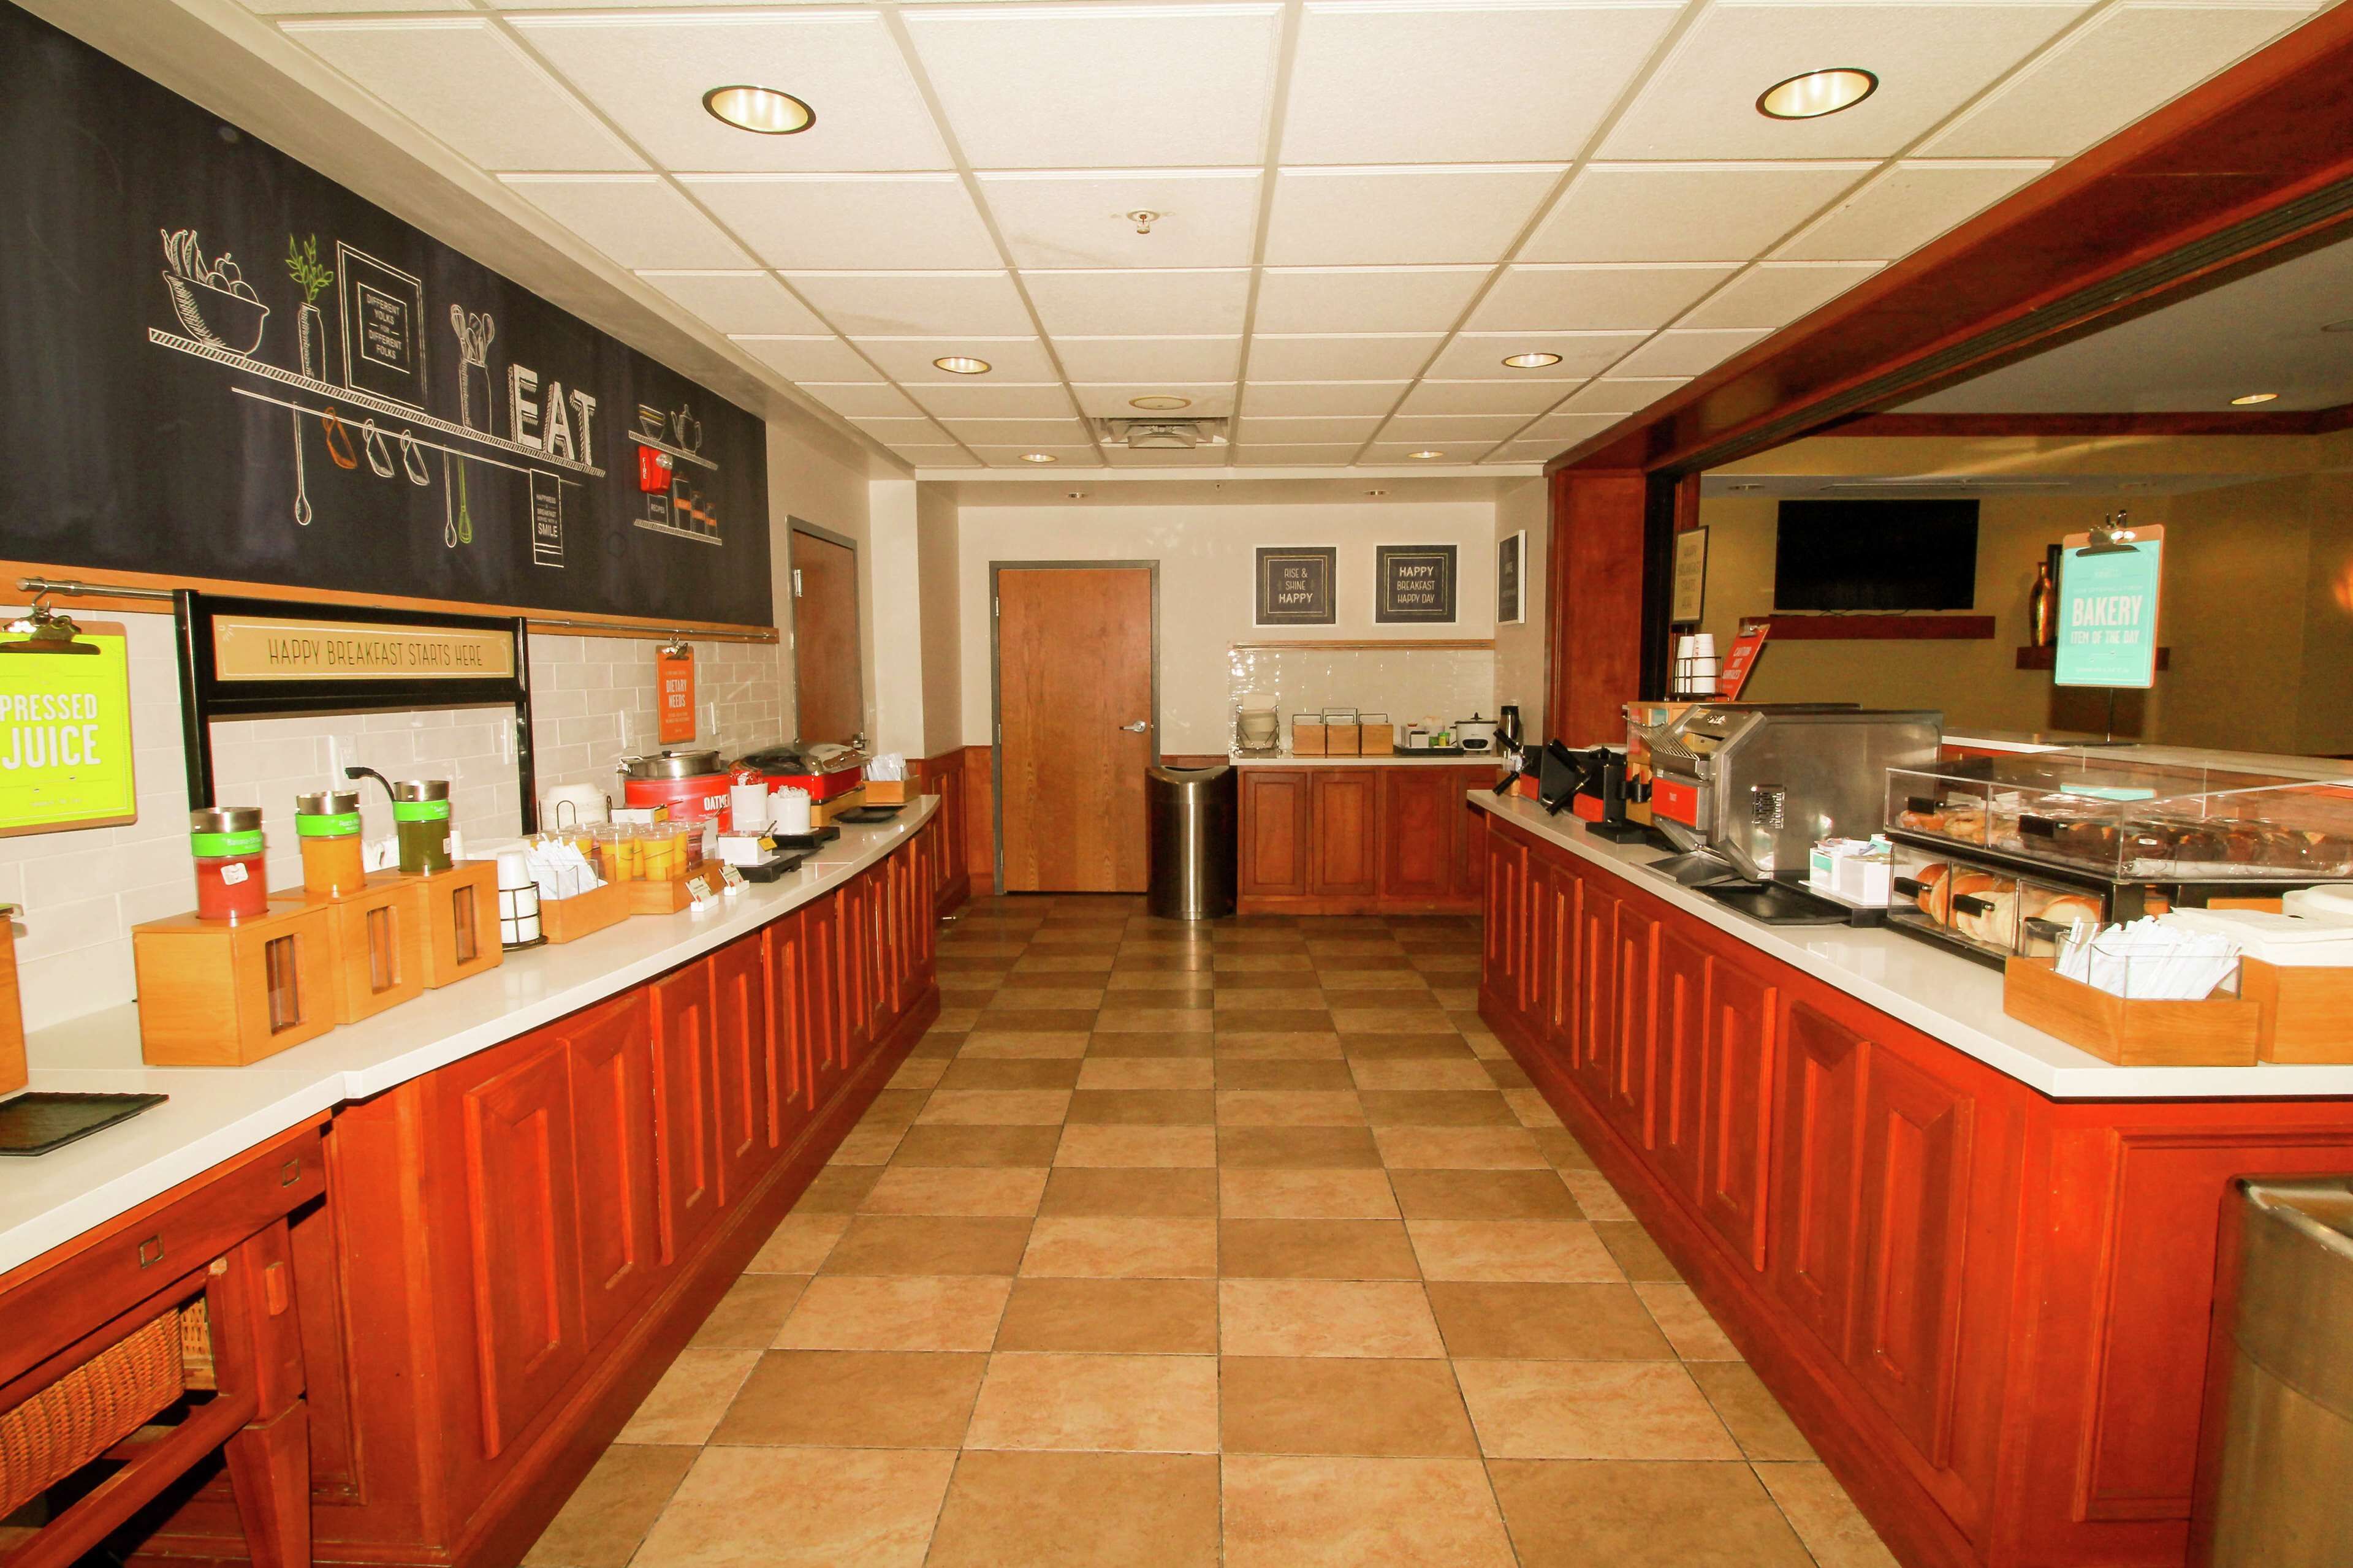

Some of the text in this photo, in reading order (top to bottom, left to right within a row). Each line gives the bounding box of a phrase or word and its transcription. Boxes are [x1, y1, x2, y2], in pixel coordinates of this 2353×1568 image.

[367, 294, 400, 316] DIFFERENT
[374, 308, 395, 325] YOLKS
[368, 328, 403, 350] DIFFERENT
[376, 344, 397, 360] FOLKS
[507, 363, 596, 468] EAT
[538, 522, 558, 539] SMILE
[1284, 567, 1308, 578] RISE &
[1399, 566, 1434, 577] HAPPY
[1285, 580, 1306, 591] SHINE
[1397, 580, 1435, 591] BREAKFAST
[1279, 592, 1313, 604] HAPPY
[1397, 593, 1435, 604] HAPPY DAY
[2071, 594, 2143, 627] BAKERY
[2070, 629, 2141, 645] ITEM OF THE DAY
[268, 638, 483, 667] HAPPY BREAKFAST STARTS HERE
[666, 678, 687, 693] DIETARY
[0, 692, 98, 722] PRESSED
[668, 694, 686, 709] NEEDS
[2, 724, 101, 770] JUICE
